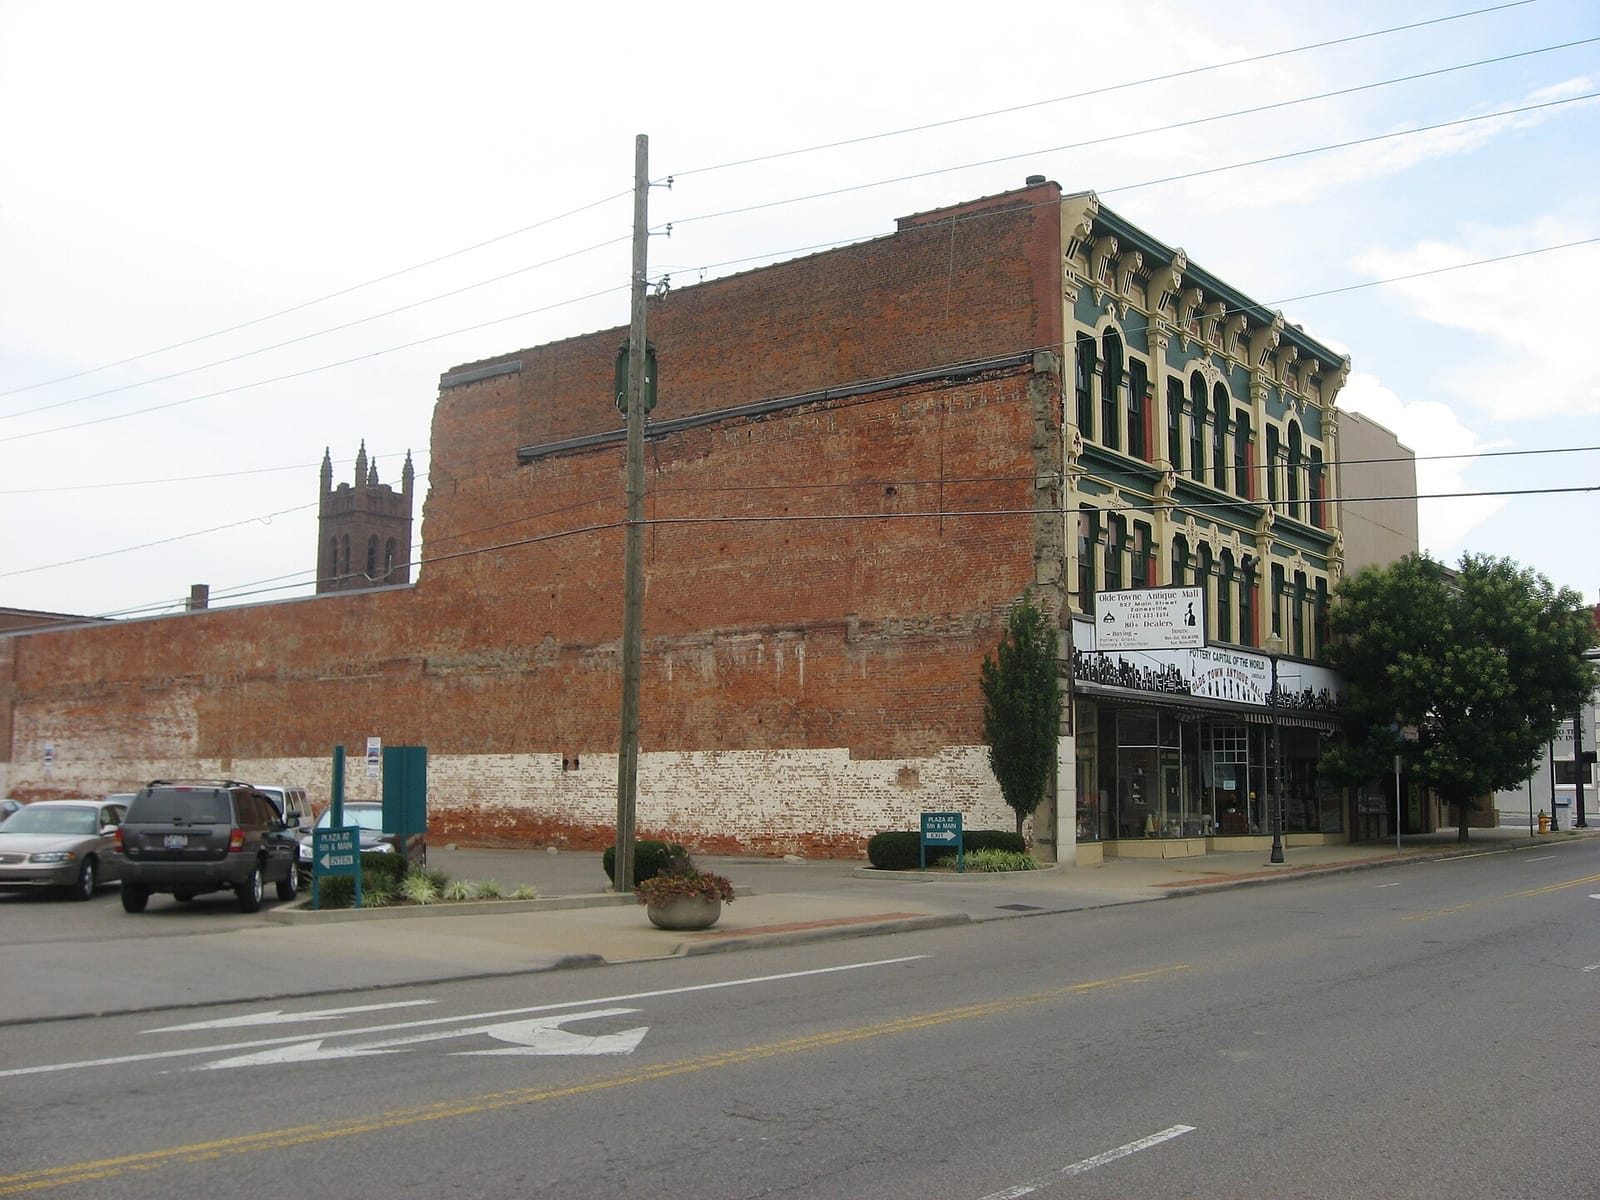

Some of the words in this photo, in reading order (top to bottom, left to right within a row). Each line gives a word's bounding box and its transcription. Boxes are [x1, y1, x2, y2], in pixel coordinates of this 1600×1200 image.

[1099, 593, 1116, 602] Olde
[1116, 592, 1142, 601] Towne
[1146, 591, 1177, 601] Antique
[1182, 589, 1199, 598] Mall
[1143, 620, 1173, 628] Dealers
[1189, 647, 1212, 660] POTTERY
[1212, 651, 1232, 664] CAPITAL
[1232, 656, 1240, 666] OF
[1239, 657, 1249, 668] THE
[1249, 659, 1265, 670] WORLD
[1191, 673, 1206, 693] OLDE
[1207, 667, 1224, 681] TOWN
[1226, 667, 1249, 685] ANTIQUE
[1249, 680, 1264, 702] MALL
[321, 833, 340, 841] PLAZA
[342, 832, 350, 840] AT
[337, 841, 353, 850] MAIN
[330, 856, 353, 864] ENTER
